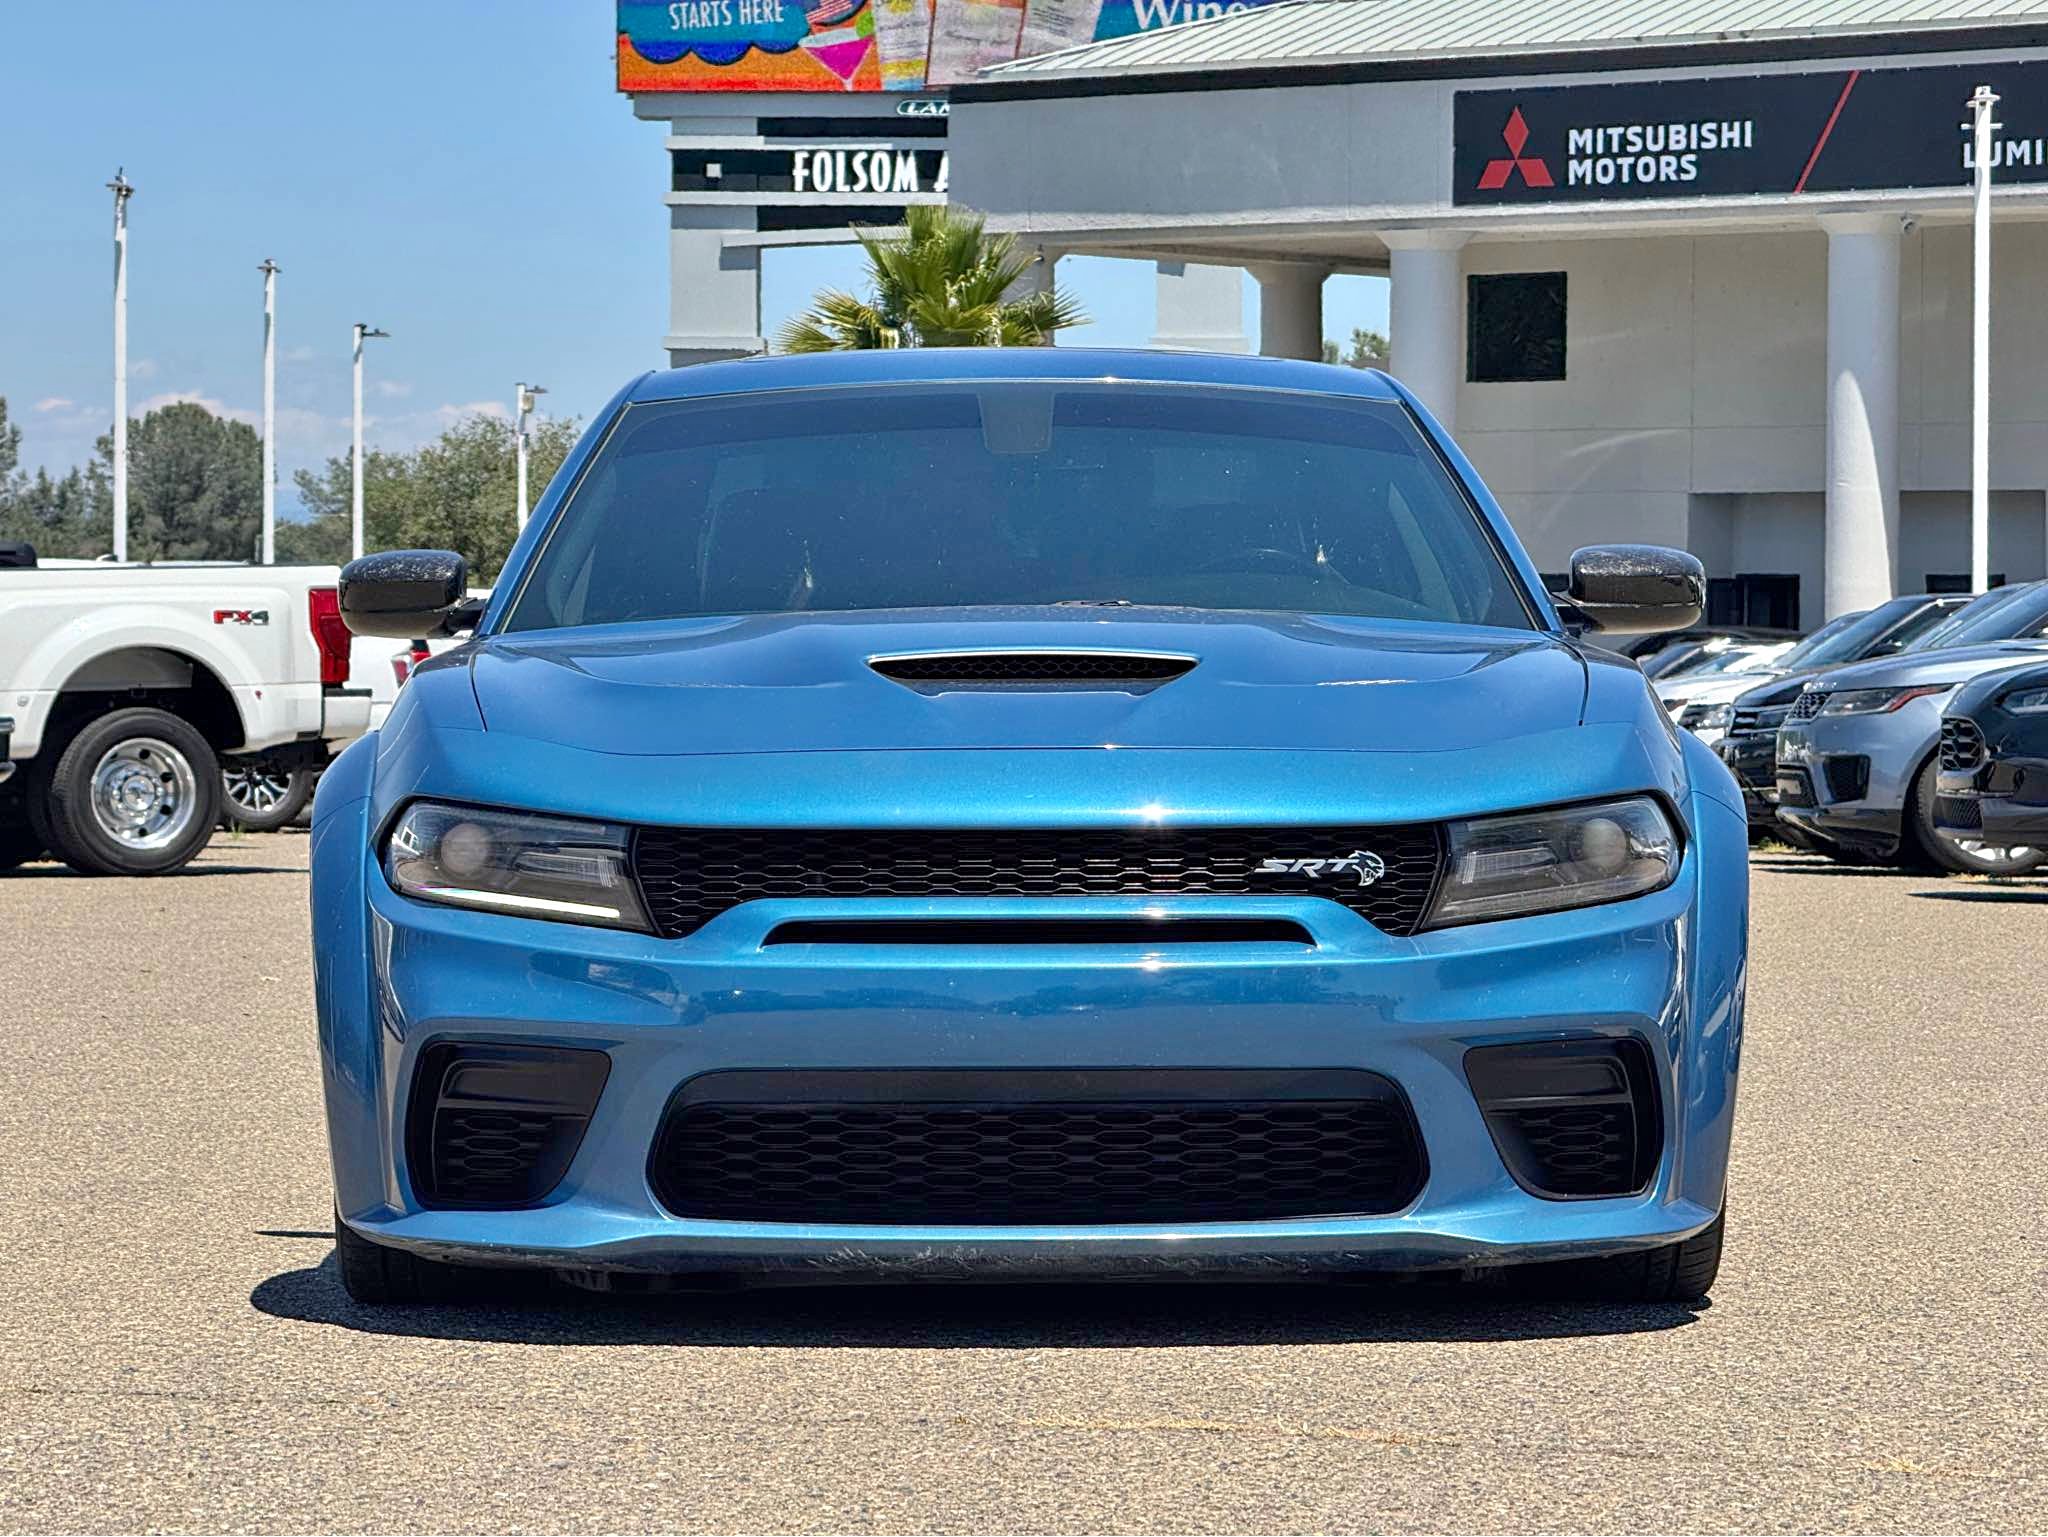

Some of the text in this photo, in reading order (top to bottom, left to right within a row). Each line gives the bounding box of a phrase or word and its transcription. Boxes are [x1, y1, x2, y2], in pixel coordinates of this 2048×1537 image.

[669, 0, 784, 30] STARTS HERE
[1568, 121, 1752, 155] MITSUBISHI
[793, 151, 919, 192] FOLSOM
[1568, 154, 1698, 186] MOTORS
[213, 610, 269, 625] FX4
[1253, 858, 1359, 878] SRT
